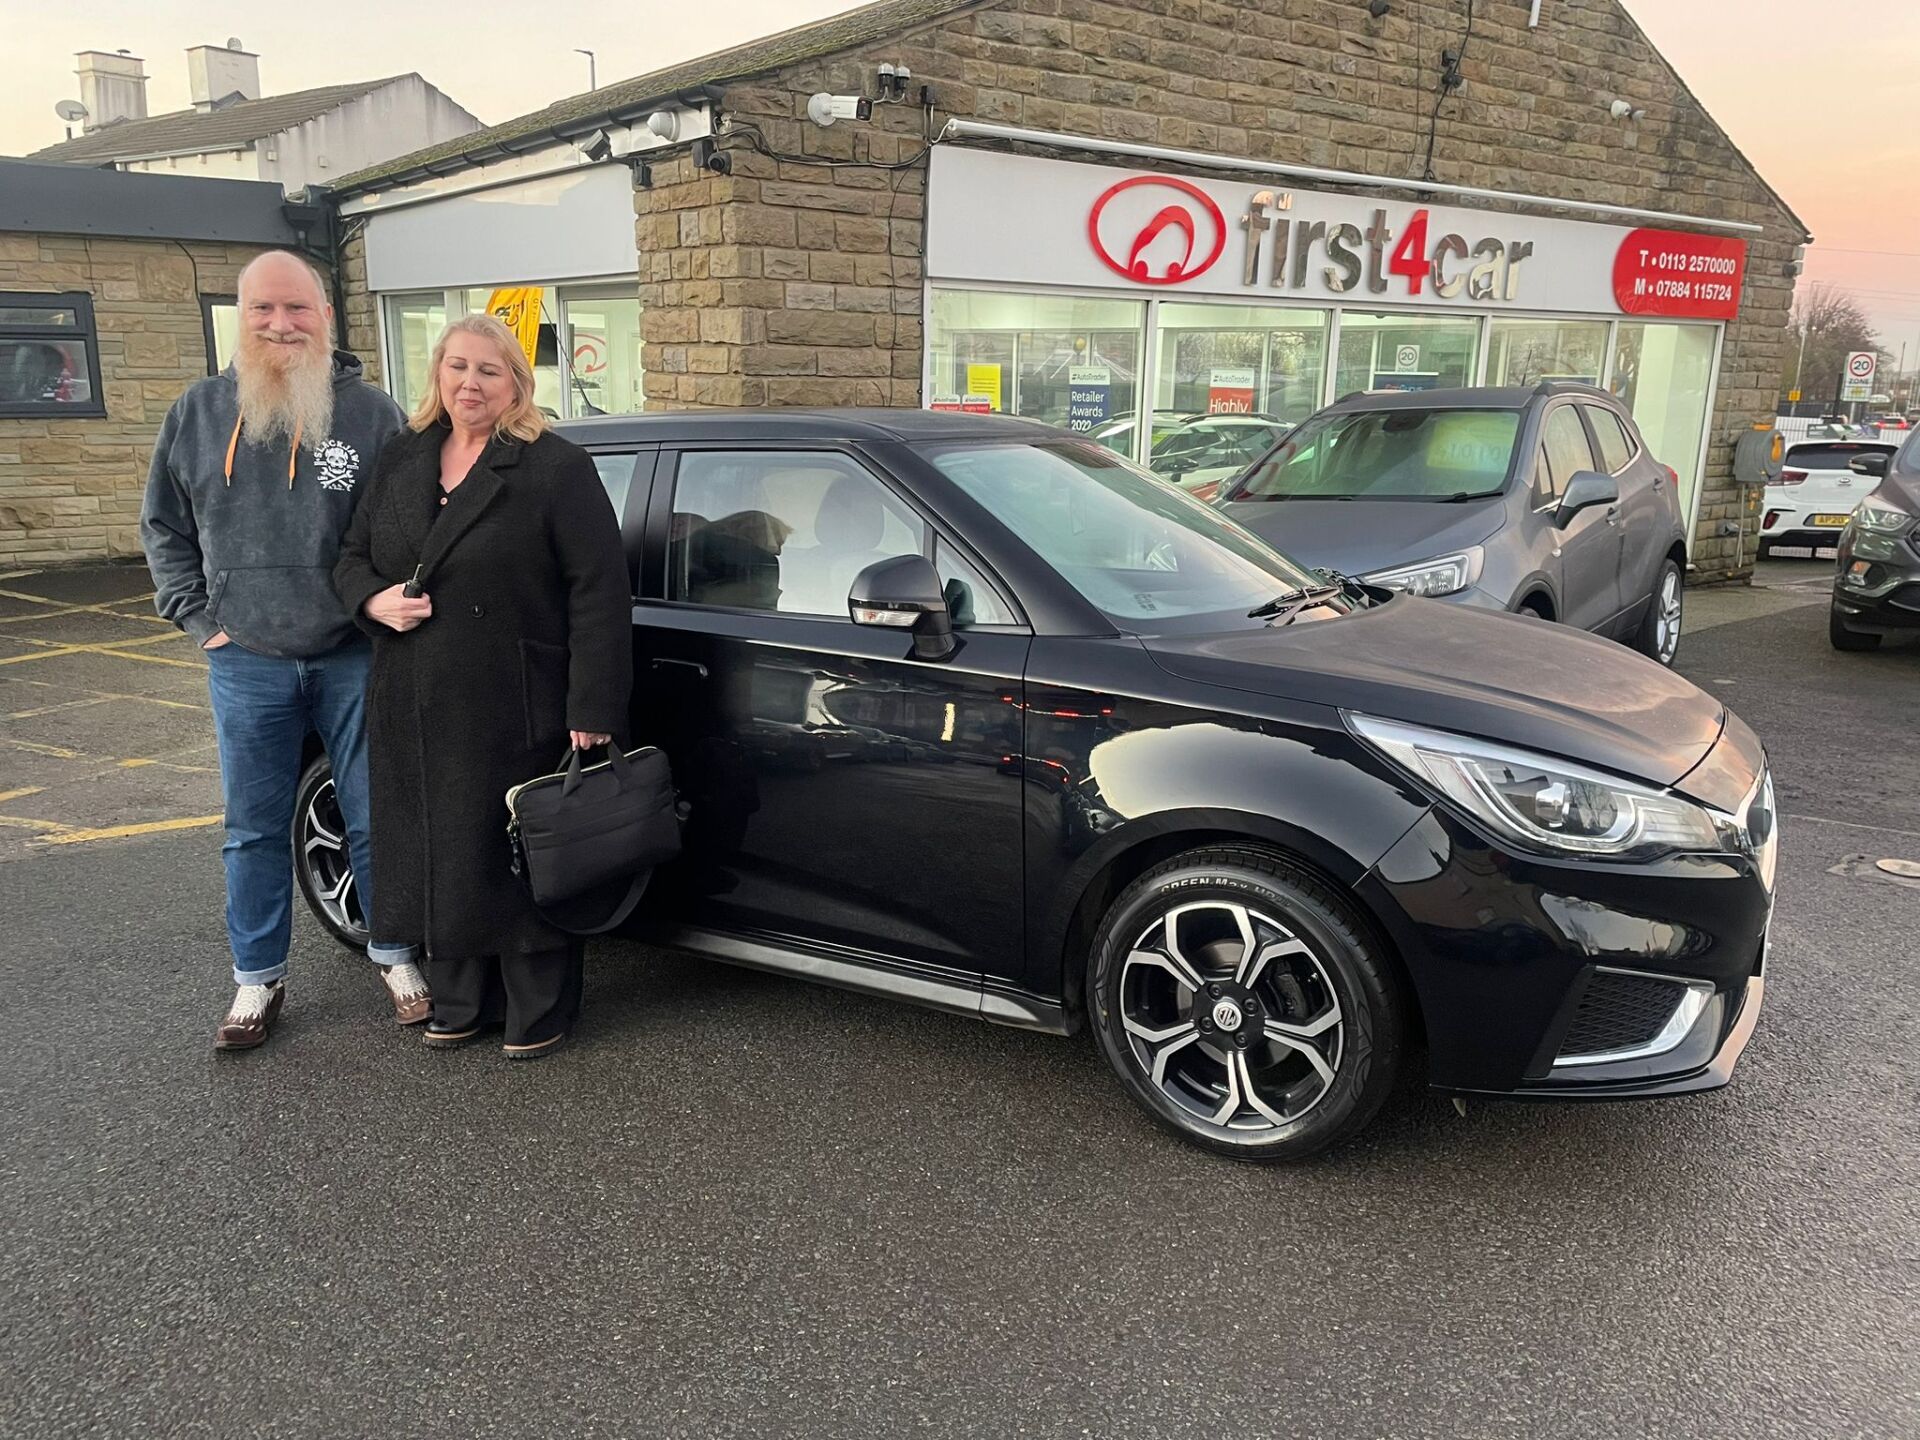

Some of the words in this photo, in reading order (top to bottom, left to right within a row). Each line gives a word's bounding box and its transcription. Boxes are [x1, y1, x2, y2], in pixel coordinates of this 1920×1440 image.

[1241, 189, 1534, 301] first4car
[1640, 250, 1649, 267] T
[1659, 252, 1686, 270] 0113
[1689, 255, 1736, 275] 2570000
[1634, 278, 1646, 295] M
[1656, 280, 1690, 298] 07884
[1694, 283, 1732, 301] 115724
[1401, 351, 1415, 361] 20
[1853, 360, 1869, 370] 20
[1071, 391, 1105, 402] Retailer
[1071, 406, 1103, 417] Awards
